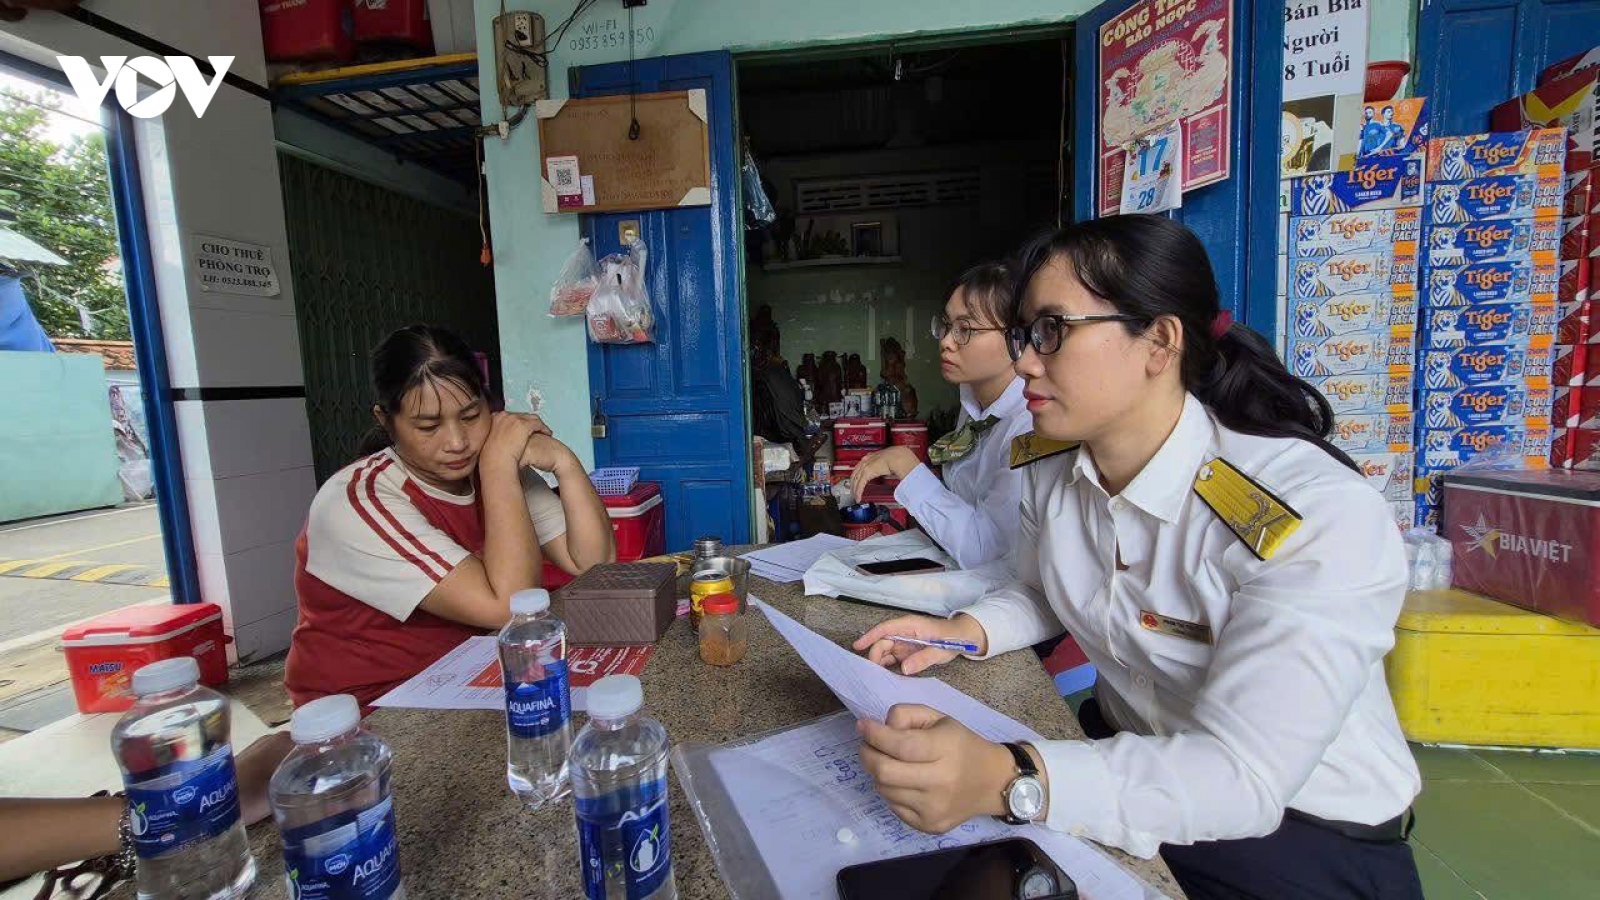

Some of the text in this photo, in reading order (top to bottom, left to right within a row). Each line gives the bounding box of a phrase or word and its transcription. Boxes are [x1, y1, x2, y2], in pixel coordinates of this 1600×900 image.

[1284, 4, 1318, 21] Bán
[1303, 50, 1349, 76] Tuổi
[1138, 137, 1168, 177] 17
[1472, 142, 1519, 165] Tiger
[1346, 164, 1398, 189] Tiger
[1137, 187, 1155, 210] 28
[1466, 181, 1515, 205] Tiger
[1330, 217, 1374, 239] Tiger
[1464, 224, 1512, 247] Tiger
[202, 243, 263, 261] CHO THUÊ
[200, 259, 270, 278] PHÒNG TRỌ
[203, 275, 219, 283] LH:
[1329, 260, 1370, 281] Tiger
[1464, 267, 1512, 290] Tiger
[1328, 301, 1370, 322] Tiger
[1465, 309, 1512, 331] Tiger
[1326, 340, 1369, 361] Tiger
[1459, 350, 1506, 372] Tiger
[1326, 380, 1368, 400] Tiger
[1460, 390, 1507, 412] Tiger
[1334, 420, 1369, 440] iger
[90, 661, 122, 674] MATSU
[508, 696, 556, 715] AQUAFINA
